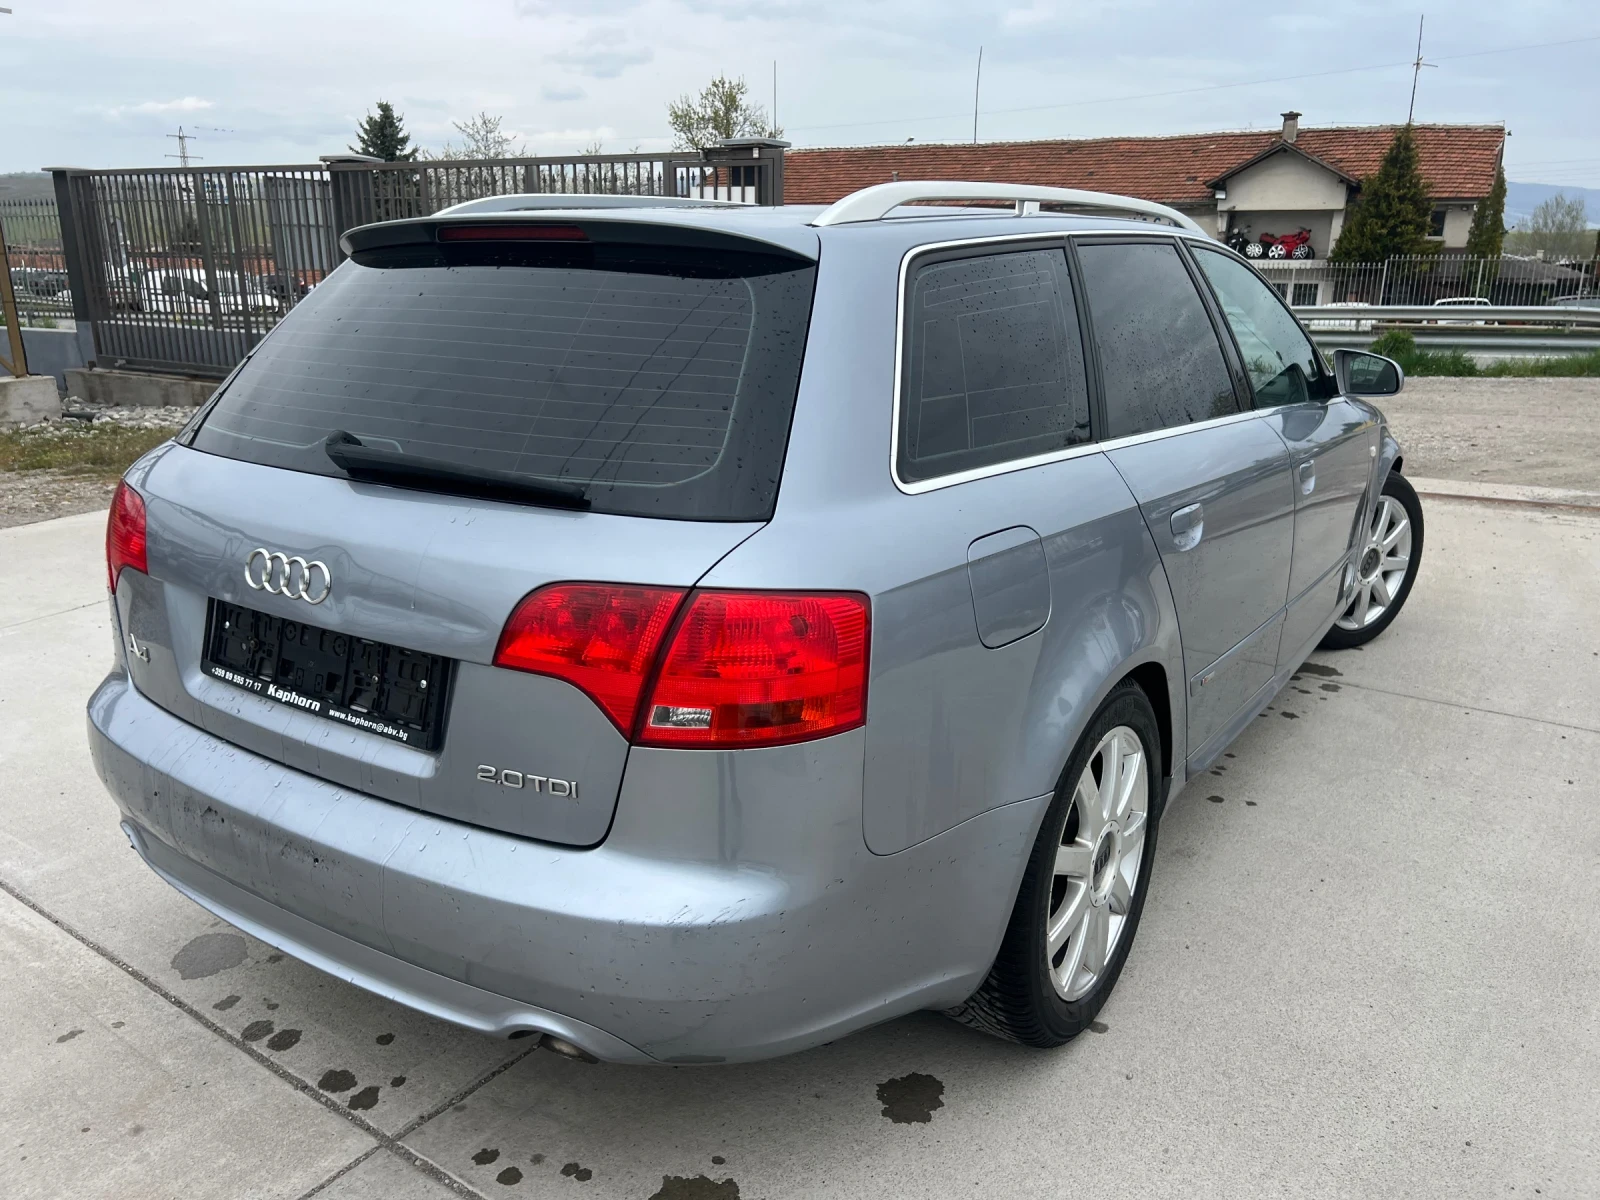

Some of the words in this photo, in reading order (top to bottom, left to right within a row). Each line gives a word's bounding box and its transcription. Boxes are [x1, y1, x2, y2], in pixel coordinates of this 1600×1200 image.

[212, 667, 225, 678] +359
[245, 678, 253, 688] 77
[254, 682, 262, 691] 17
[267, 683, 320, 711] Kaphorn
[328, 709, 408, 741] www.kaphorn@abv.bg
